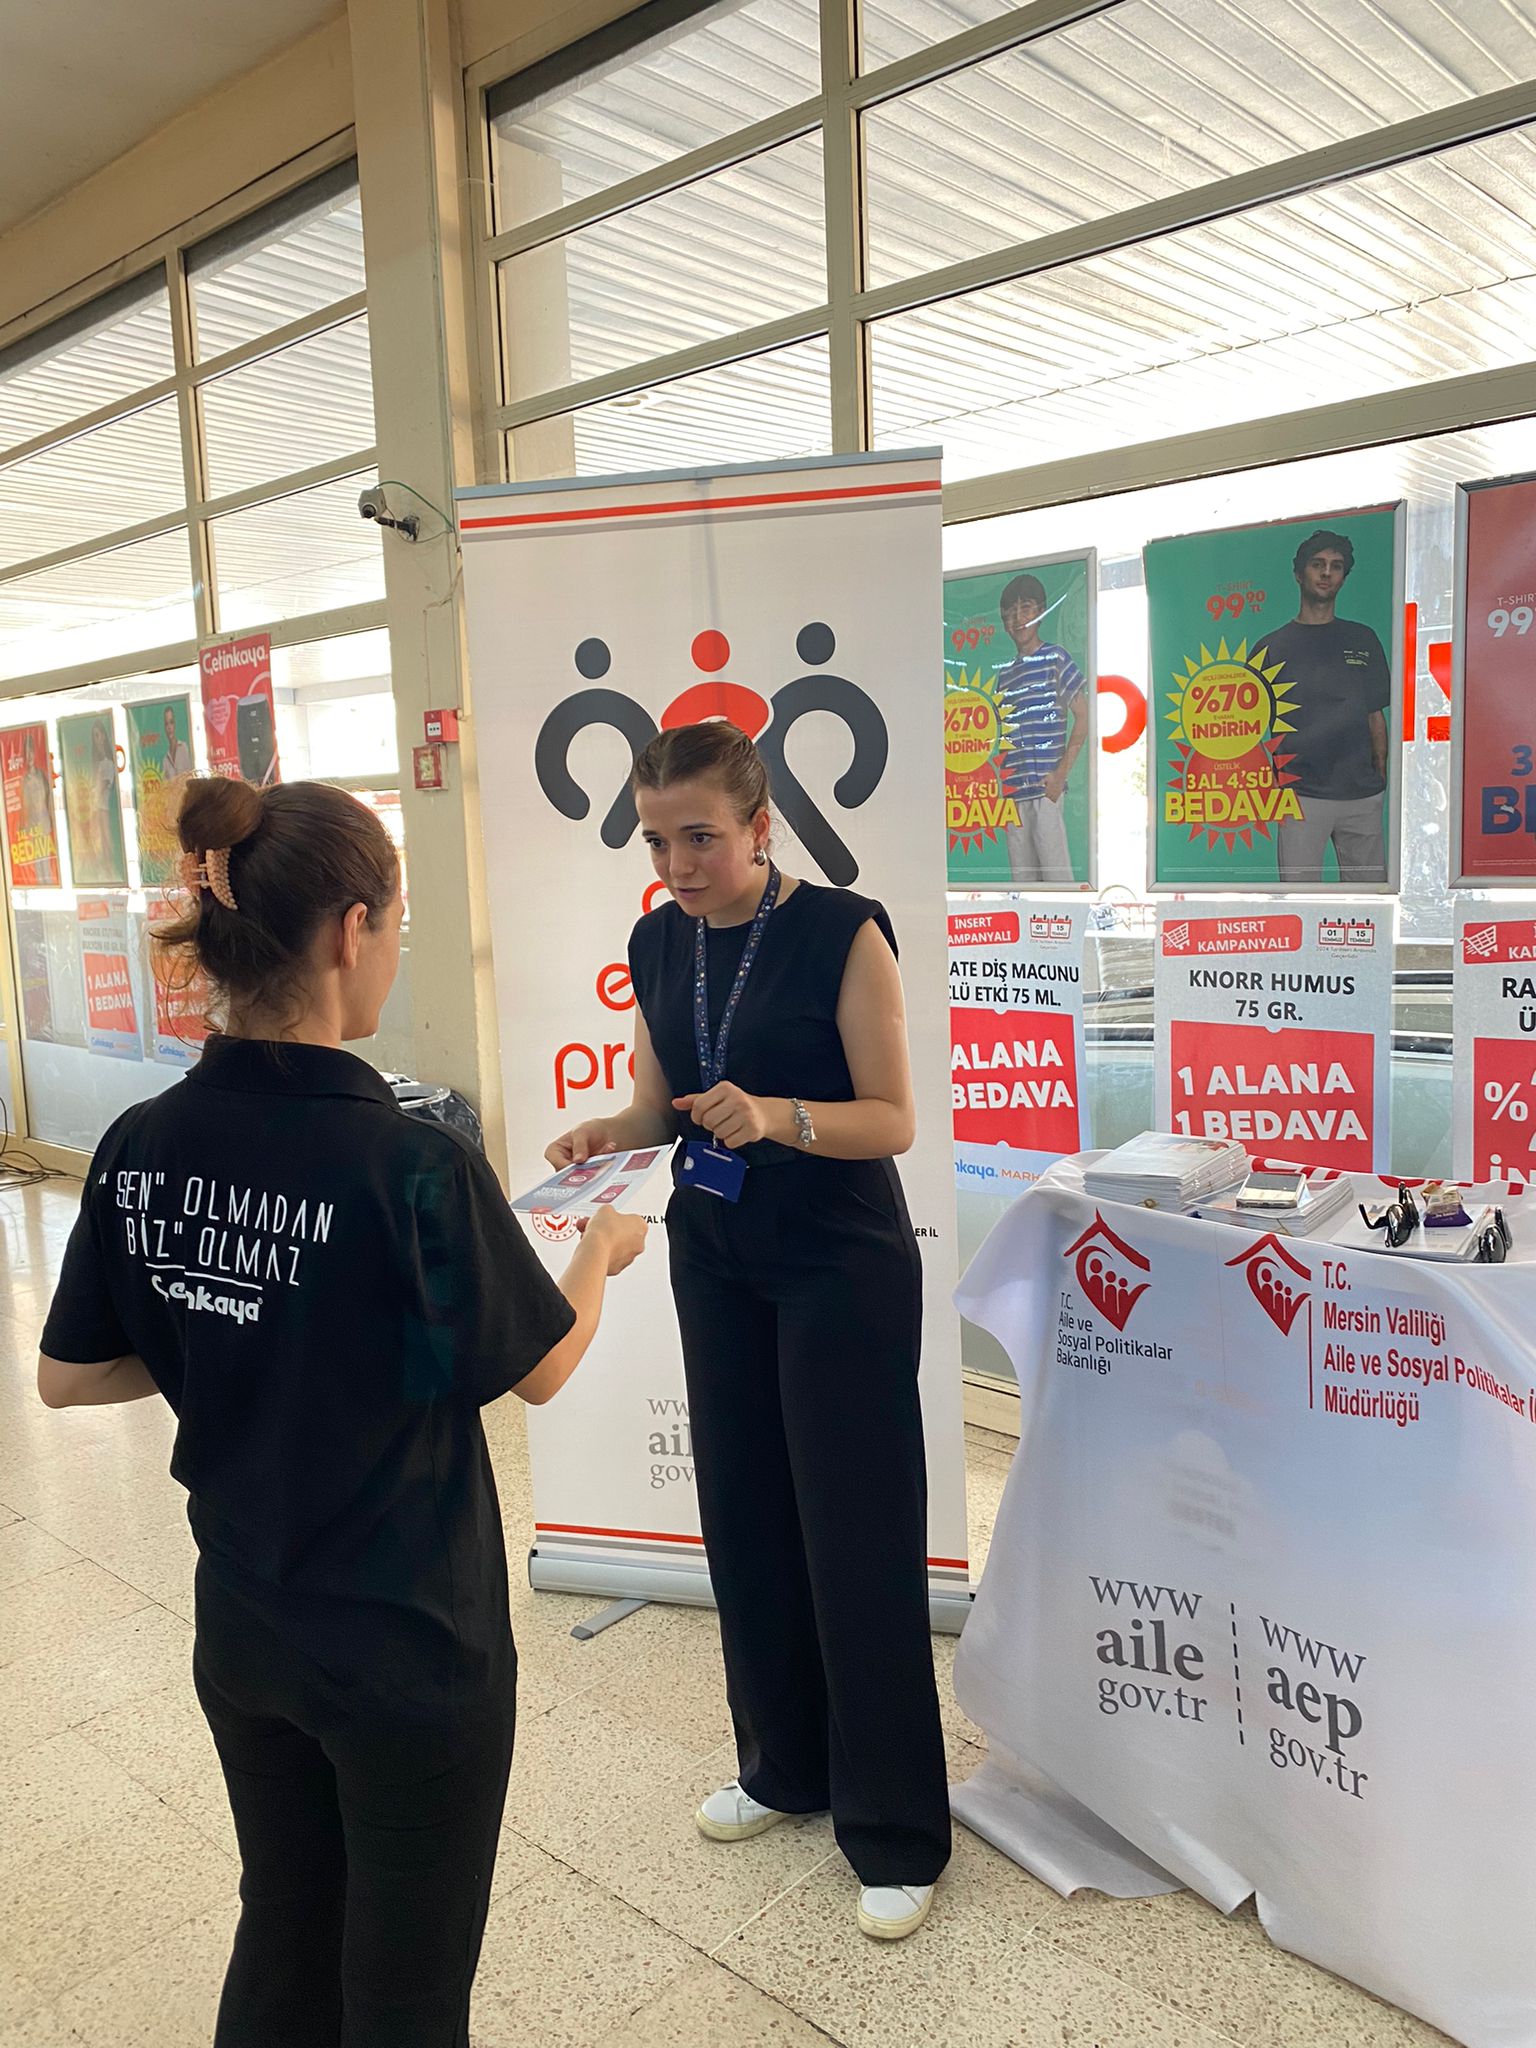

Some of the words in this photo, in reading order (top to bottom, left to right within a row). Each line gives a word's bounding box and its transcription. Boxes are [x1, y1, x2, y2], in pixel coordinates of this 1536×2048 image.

[1497, 592, 1536, 606] T-SHIR
[1191, 682, 1260, 714] %70
[1165, 787, 1304, 823] BEDAVA
[954, 916, 992, 930] İNSERT
[1217, 920, 1266, 935] İNSERT
[1327, 929, 1337, 937] 01
[1198, 937, 1290, 952] KAMPANYALI
[982, 958, 1007, 982] DİŞ
[1012, 963, 1080, 983] MACUNU
[1189, 970, 1264, 991] KNORR
[1271, 973, 1356, 995] HUMUS
[949, 982, 970, 1001] LÜ
[975, 984, 1008, 1003] ETKİ
[1012, 988, 1030, 1004] 75
[1035, 989, 1062, 1007] ML.
[1236, 999, 1260, 1018] 75
[1267, 1001, 1304, 1021] GR.
[951, 1039, 1064, 1070] ALANA
[1177, 1066, 1194, 1096] 1
[1206, 1062, 1356, 1095] ALANA
[952, 1080, 1075, 1110] BEDAVA
[1175, 1110, 1192, 1136] 1
[1203, 1109, 1368, 1141] BEDAVA
[183, 1176, 334, 1243] OLMADAN
[198, 1226, 300, 1287] OLMAZ
[1322, 1260, 1352, 1290] T.C.
[1077, 1319, 1093, 1332] ve
[1324, 1301, 1381, 1333] Mersin
[1385, 1306, 1447, 1347] Valiliği
[1057, 1329, 1091, 1352] Sosyal
[1095, 1336, 1173, 1360] Politikalar
[1056, 1347, 1112, 1375] Bakanlığı
[1323, 1343, 1356, 1374] Aile
[1361, 1354, 1382, 1376] ve
[1387, 1348, 1449, 1387] Sosyal
[1454, 1356, 1525, 1417] Politikalar
[1324, 1384, 1420, 1428] Müdürlüğü
[1089, 1575, 1203, 1619] www
[1096, 1618, 1205, 1681] aile
[1259, 1615, 1367, 1684] www
[1098, 1677, 1208, 1722] gov.tr
[1266, 1666, 1363, 1757] aep
[1270, 1727, 1369, 1801] gov.tr
